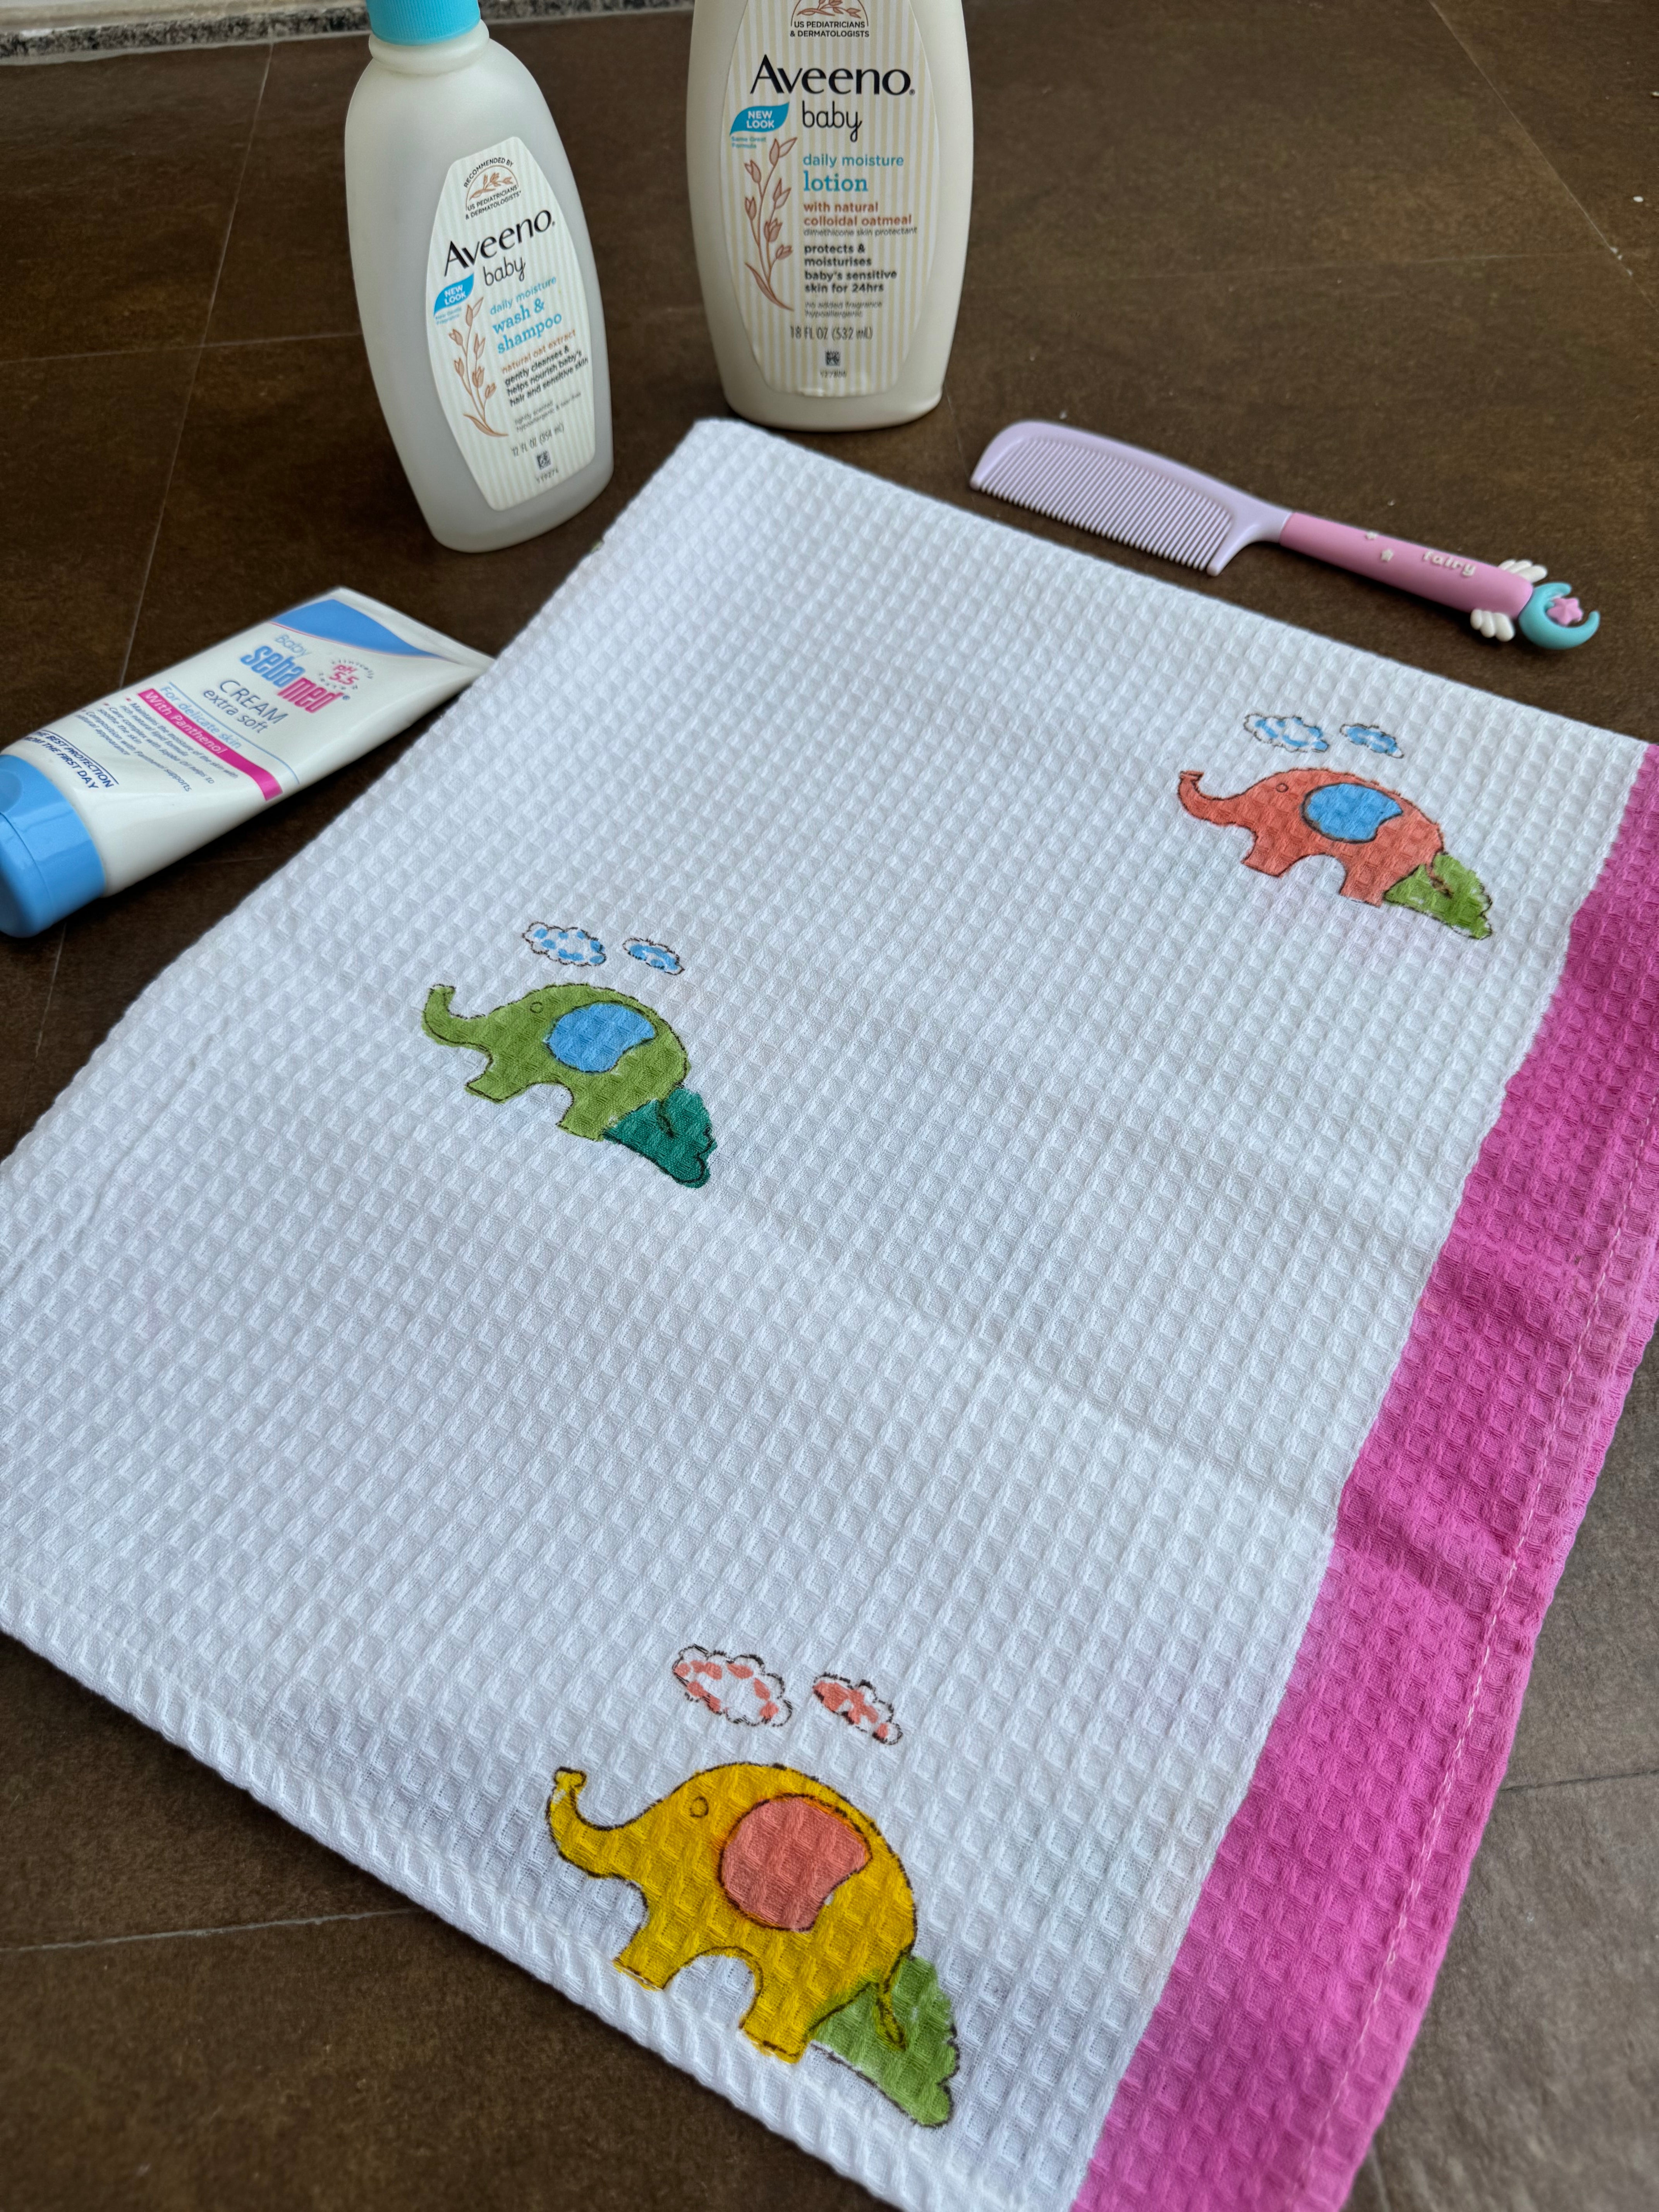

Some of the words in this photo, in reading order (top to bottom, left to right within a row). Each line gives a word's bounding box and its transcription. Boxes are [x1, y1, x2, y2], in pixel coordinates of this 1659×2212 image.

[750, 54, 912, 95] Aveeno
[746, 120, 775, 129] LOOK
[747, 110, 773, 119] NEW
[802, 100, 862, 143] baby
[464, 157, 505, 188] RECOMMENDED
[506, 159, 514, 167] BY
[803, 153, 837, 168] daily
[842, 154, 904, 167] moisture
[803, 170, 868, 192] lotion
[477, 185, 518, 208] PEDIATRICIANS
[803, 201, 830, 212] with
[835, 201, 878, 212] natural
[803, 228, 854, 236] dimethicone
[856, 227, 872, 236] skin
[804, 215, 857, 226] colloidal
[861, 213, 912, 226] oatmeal
[444, 210, 552, 277] Aveeno
[804, 244, 854, 255] protects
[857, 243, 866, 253] &
[483, 256, 526, 286] baby
[804, 257, 872, 267] moisturises
[805, 270, 843, 283] baby's
[846, 269, 897, 280] sensitive
[444, 284, 463, 298] NEW
[444, 291, 466, 306] LOOK
[490, 297, 513, 315] daily
[516, 276, 556, 303] moisture
[805, 283, 828, 293] skin
[831, 282, 848, 293] for
[852, 282, 884, 293] 24hrs
[492, 304, 531, 334] wash
[534, 298, 544, 313] &
[498, 313, 562, 354] shampoo
[790, 325, 801, 340] 18
[804, 326, 813, 340] FL
[816, 326, 828, 340] OZ
[832, 326, 854, 341] (532
[501, 353, 532, 374] natural
[533, 344, 546, 358] oat
[548, 329, 575, 349] extract
[505, 368, 529, 386] gently
[531, 350, 563, 372] cleanses
[564, 345, 569, 354] &
[506, 381, 529, 397] helps
[530, 364, 558, 385] nourish
[558, 349, 582, 368] baby's
[509, 393, 525, 407] hair
[527, 385, 541, 398] and
[543, 366, 574, 390] sensitive
[575, 357, 589, 371] skin
[511, 446, 519, 457] 12
[520, 442, 528, 453] FL
[529, 436, 538, 449] OZ
[1423, 550, 1476, 576] fairy
[275, 634, 311, 657] Baby
[329, 672, 359, 685] 5.5
[333, 665, 357, 674] pH
[203, 690, 239, 716] extra
[237, 715, 268, 733] soft
[220, 680, 289, 724] CREAM
[98, 709, 119, 725] soothe
[118, 725, 130, 734] the
[127, 733, 142, 744] skin
[109, 707, 124, 719] Care
[123, 719, 147, 739] complex
[146, 738, 161, 749] with
[130, 703, 158, 726] Maintains
[157, 725, 169, 733] the
[168, 733, 194, 751] moisture
[132, 715, 154, 732] natural
[145, 692, 172, 716] With
[170, 715, 228, 754] Panthenol
[160, 686, 180, 701] For
[179, 702, 220, 734] delicate
[218, 733, 242, 749] skin
[41, 743, 62, 753] THE
[57, 752, 82, 769] FIRST
[77, 770, 100, 788] DAY
[45, 735, 69, 747] BEST
[64, 747, 115, 788] PROTECTION
[86, 711, 122, 740] Composition
[121, 740, 136, 751] with
[163, 768, 192, 793] supports
